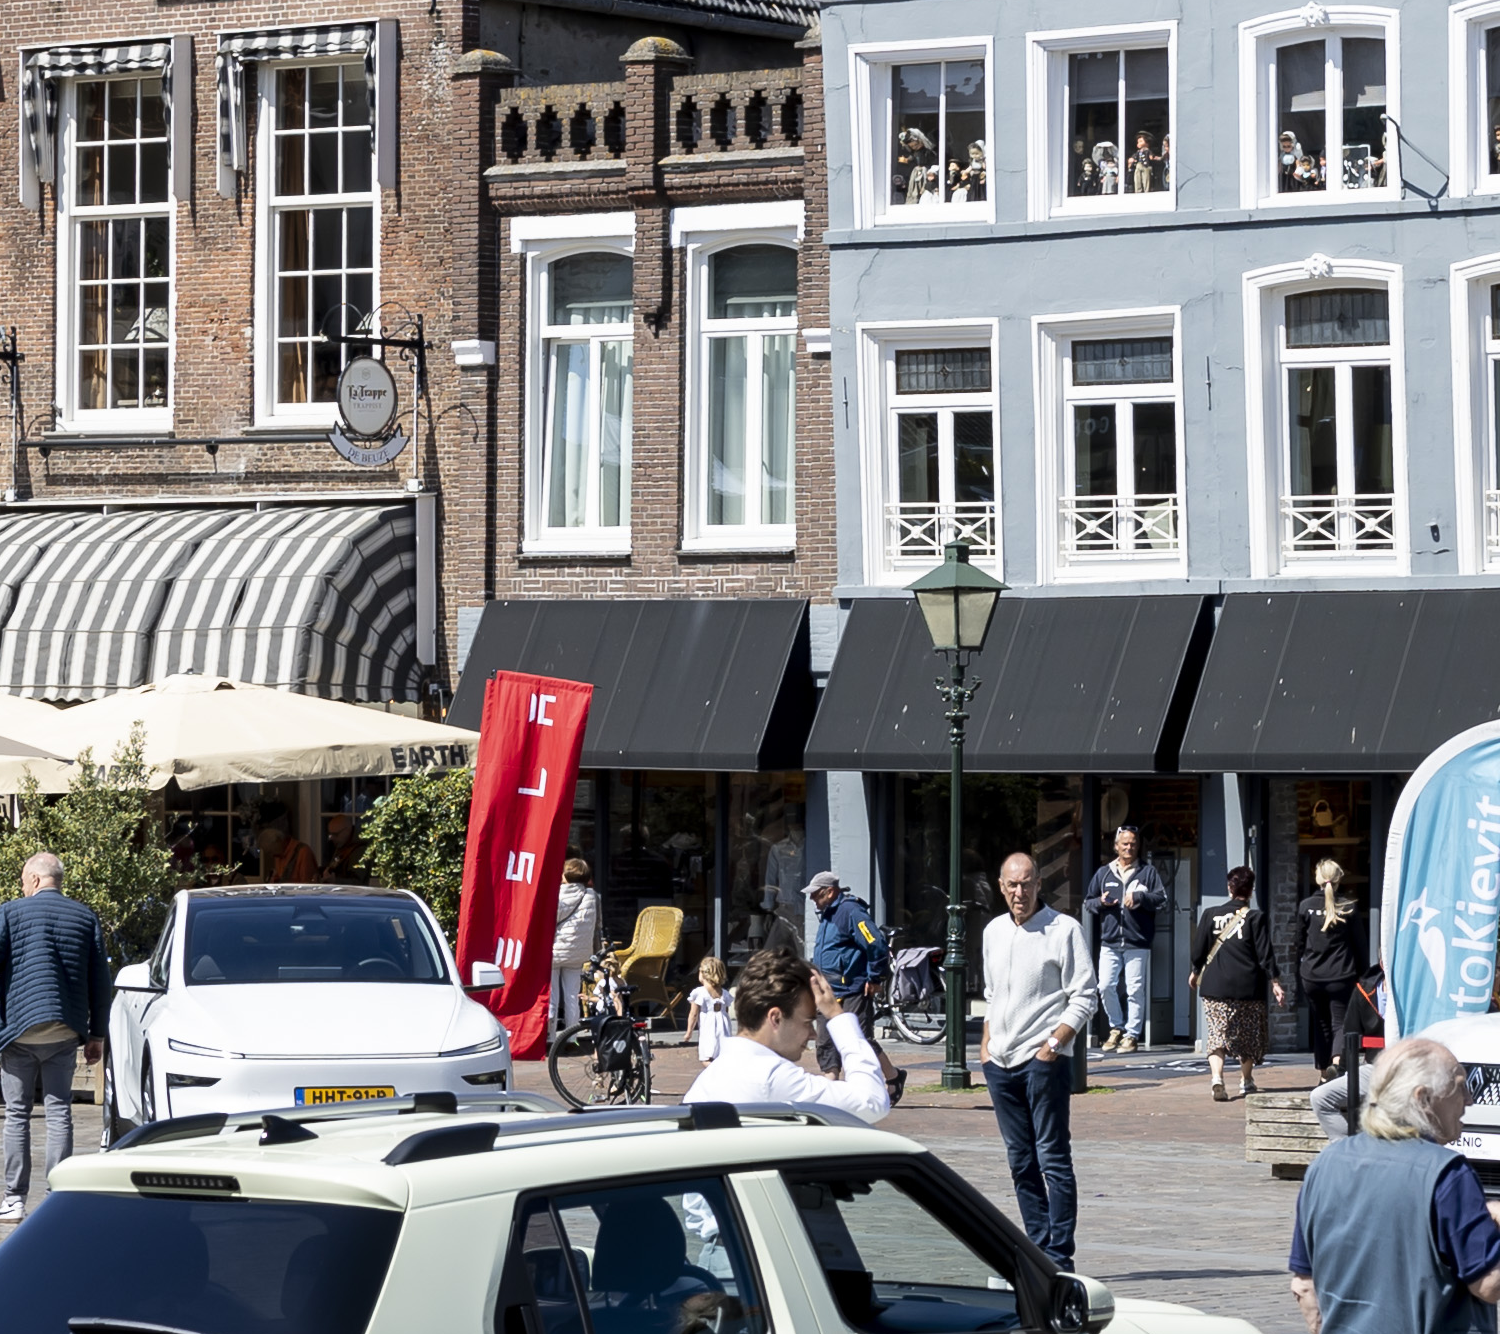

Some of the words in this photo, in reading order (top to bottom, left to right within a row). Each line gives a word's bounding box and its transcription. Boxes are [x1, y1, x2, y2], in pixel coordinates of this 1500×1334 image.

[358, 384, 387, 401] Trappe
[347, 447, 360, 459] DE
[361, 449, 389, 463] BEUZE
[390, 744, 466, 768] EARTH
[494, 691, 557, 1039] ESLA
[1450, 1137, 1482, 1148] ENIC
